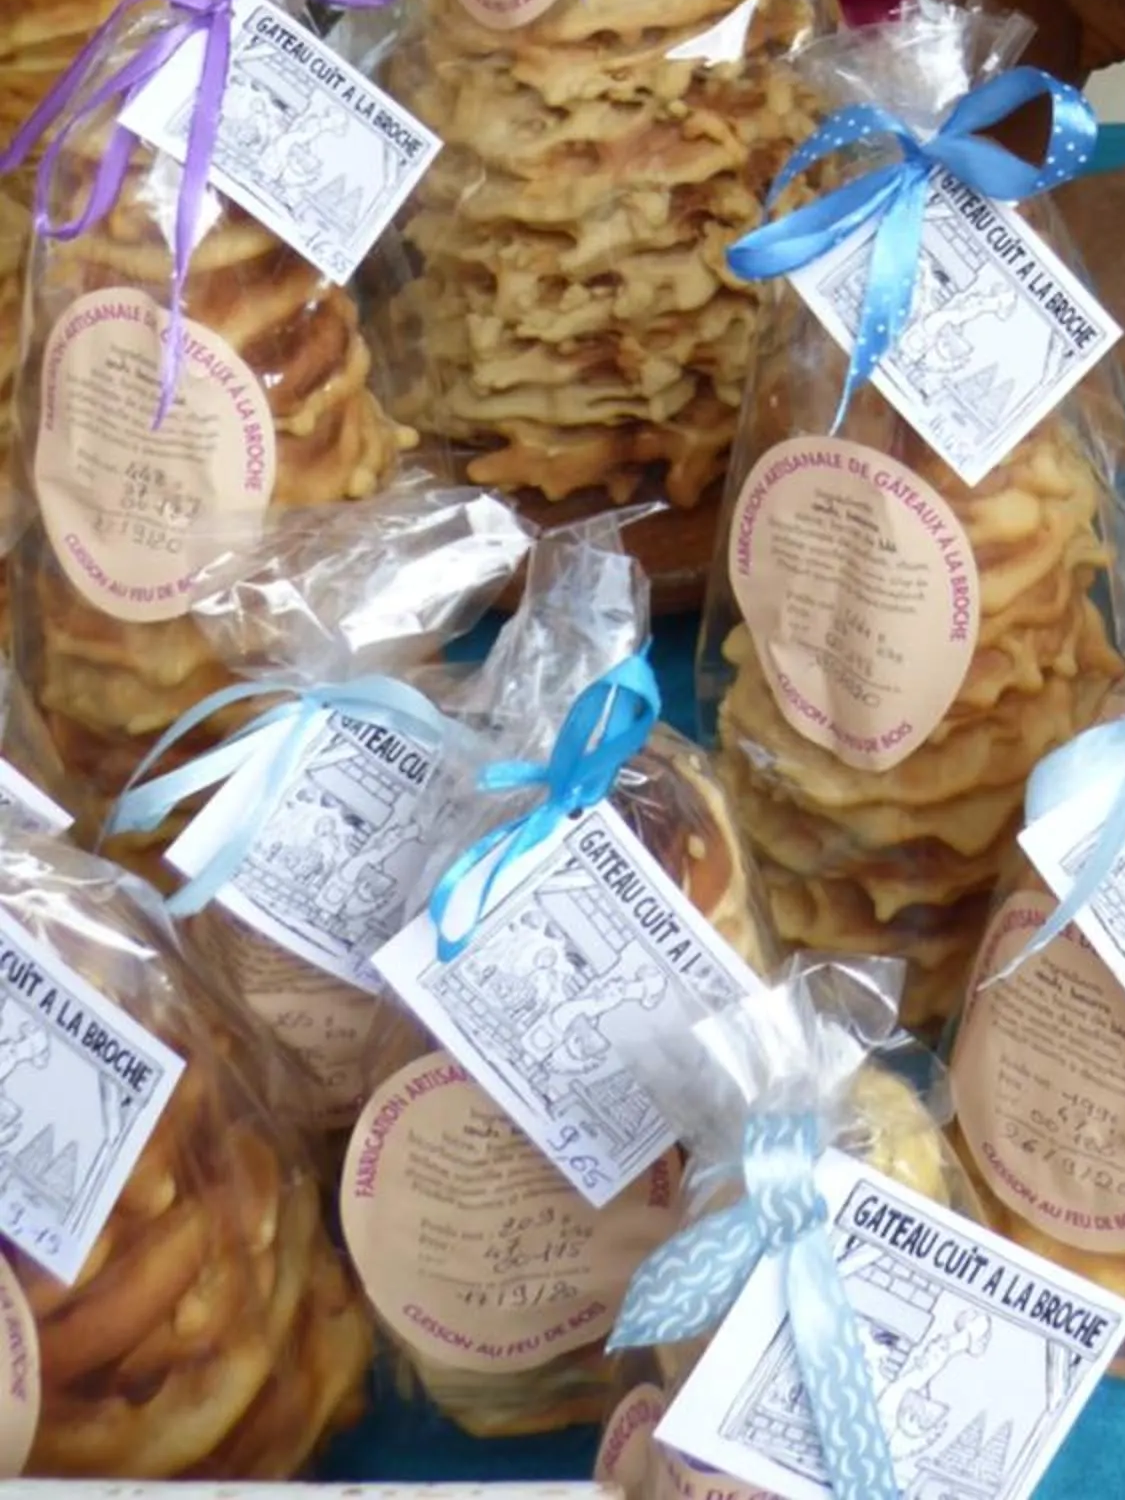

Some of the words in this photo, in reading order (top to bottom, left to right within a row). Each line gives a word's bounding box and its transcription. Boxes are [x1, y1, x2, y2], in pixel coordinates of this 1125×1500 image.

[256, 16, 312, 64] GATEAU
[341, 86, 355, 101] A
[355, 94, 375, 117] LA
[372, 108, 423, 159] BROCHE
[64, 303, 141, 340] ARTISANALE
[1016, 262, 1036, 283] A
[1027, 272, 1053, 303] LA
[1045, 290, 1098, 350] BROCHE
[236, 399, 254, 419] LA
[243, 423, 265, 492] BROCHE
[765, 451, 843, 490] ARTISANALE
[848, 458, 871, 480] DE
[739, 483, 766, 576] FABRICATION
[945, 550, 963, 573] LA
[64, 533, 109, 589] CUISSON
[158, 586, 174, 600] DE
[950, 576, 971, 642] BROCHE
[577, 829, 646, 904] GATEAU
[668, 939, 691, 963] A
[39, 988, 57, 1015] A
[56, 1000, 83, 1037] LA
[82, 1021, 152, 1092] BROCHE
[355, 1092, 408, 1199] FABRICATION
[981, 1140, 1036, 1205] CUISSON
[1039, 1200, 1061, 1220] AU
[1064, 1209, 1092, 1229] FEU
[854, 1195, 940, 1259] GATEAU
[982, 1266, 1005, 1297] A
[1001, 1275, 1034, 1313] LA
[1030, 1289, 1108, 1348] BROCHE
[402, 1302, 474, 1351] CUISSON
[476, 1344, 502, 1359] AU
[506, 1335, 541, 1356] FEU
[544, 1323, 566, 1343] DE
[569, 1301, 607, 1329] BOIS
